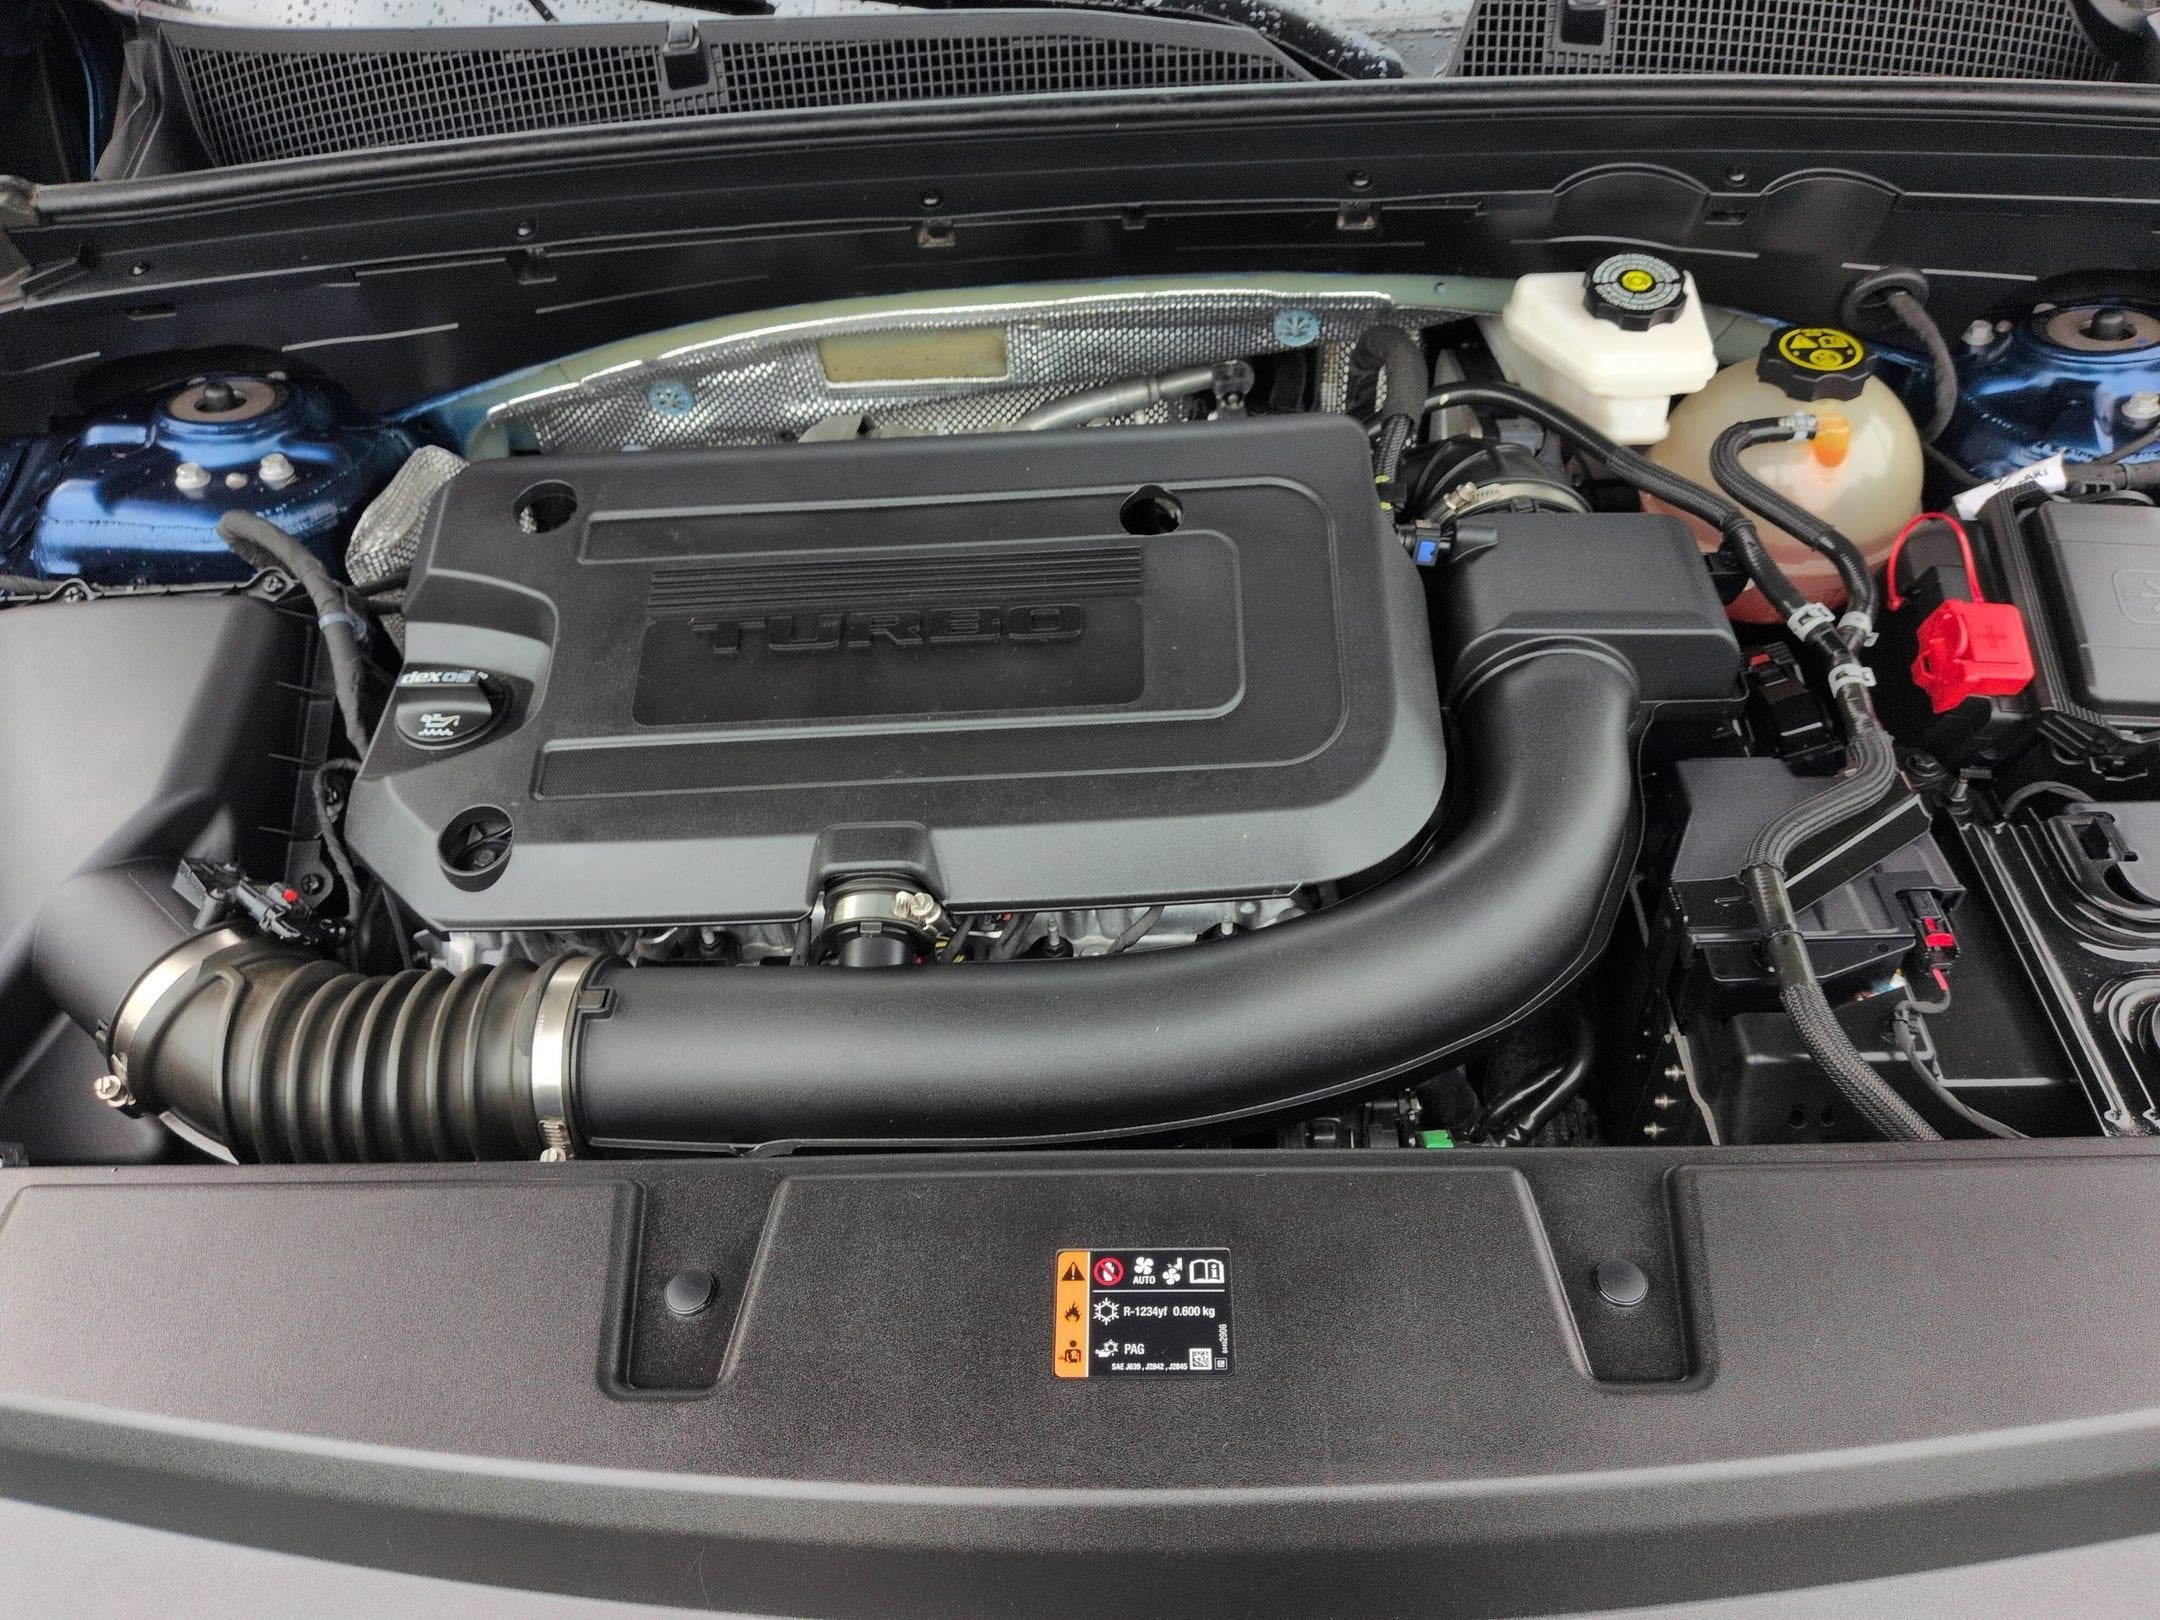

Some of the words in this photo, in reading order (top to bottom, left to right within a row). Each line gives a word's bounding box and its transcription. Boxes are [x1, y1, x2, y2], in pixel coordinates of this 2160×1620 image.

[691, 603, 1084, 655] TURBO
[401, 671, 472, 684] dexos
[1133, 1275, 1156, 1285] AUTO
[1123, 1306, 1168, 1319] R-1234yf
[1172, 1306, 1201, 1317] 0.600
[1202, 1305, 1216, 1319] kg
[1124, 1343, 1145, 1355] PAG
[1111, 1362, 1125, 1371] SAE
